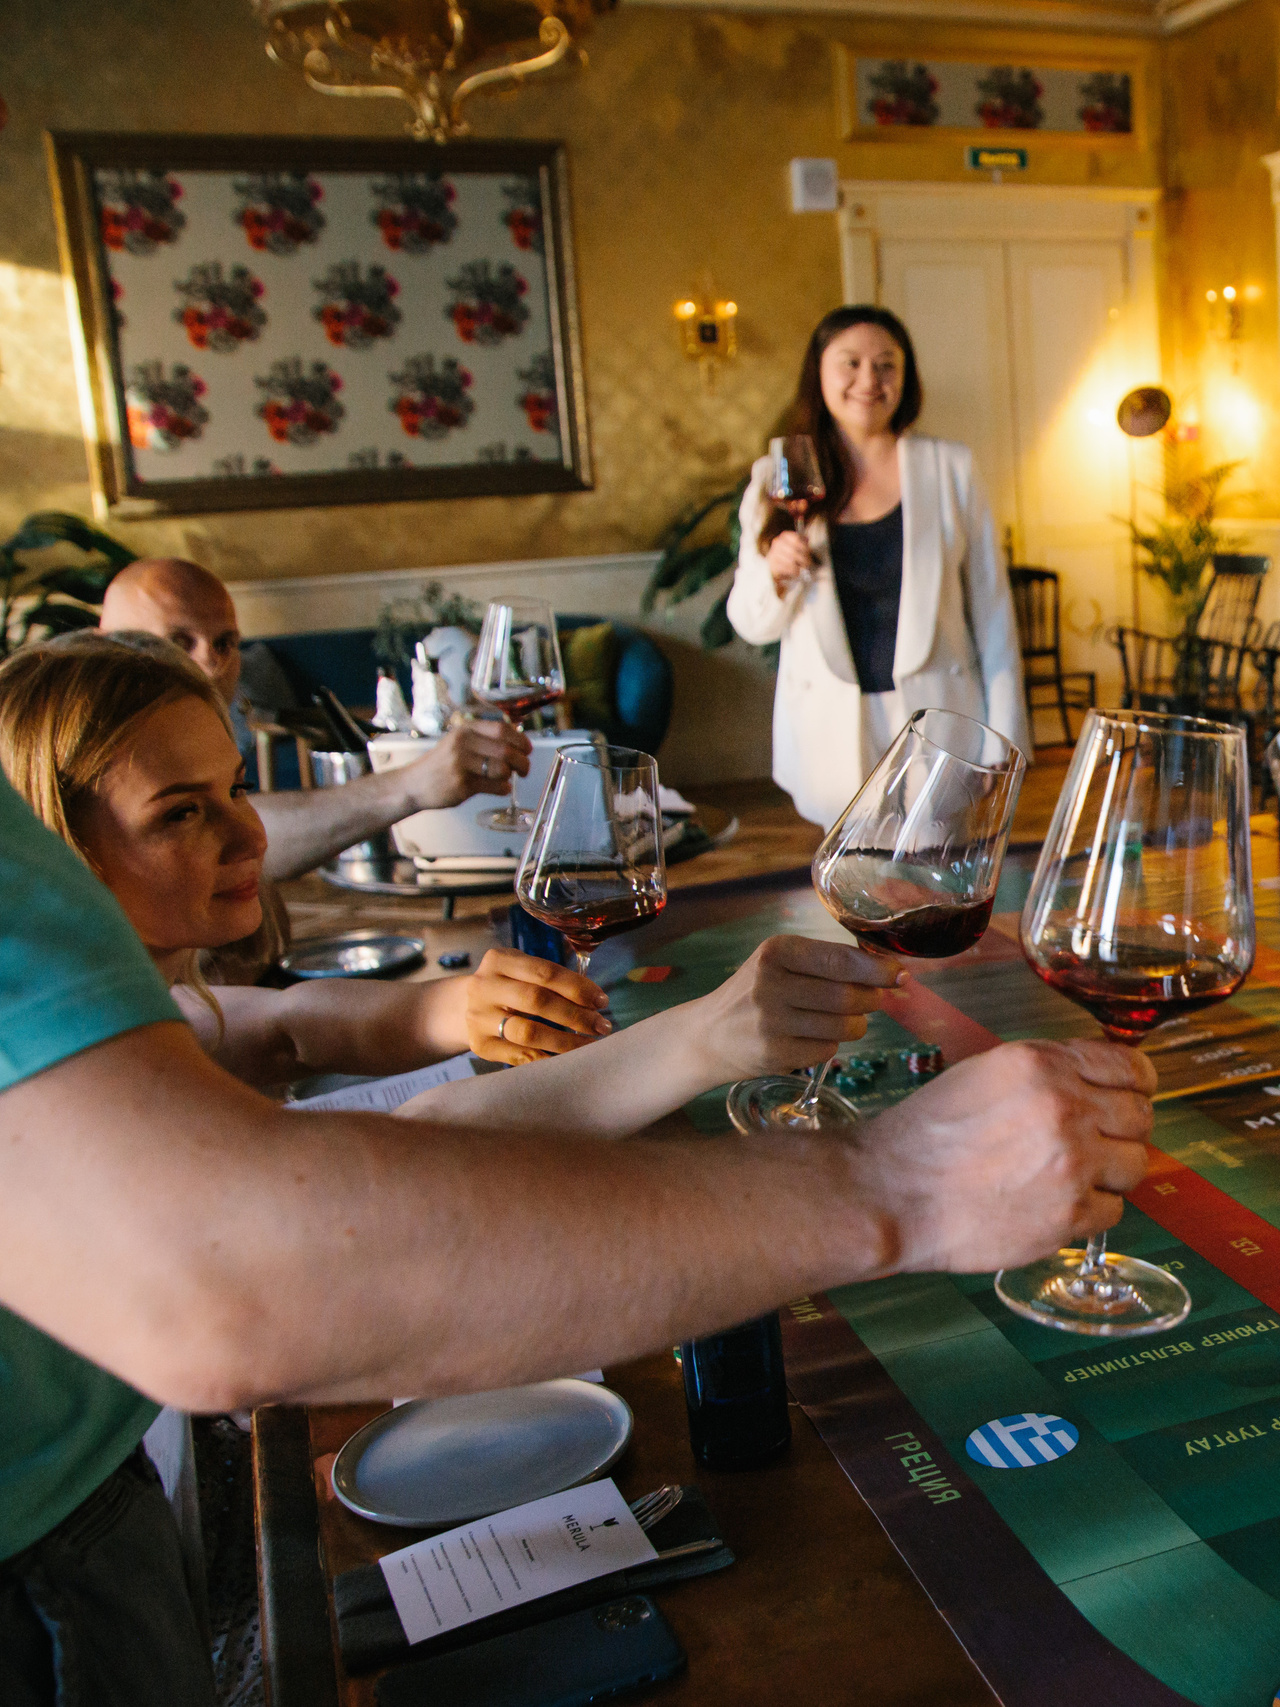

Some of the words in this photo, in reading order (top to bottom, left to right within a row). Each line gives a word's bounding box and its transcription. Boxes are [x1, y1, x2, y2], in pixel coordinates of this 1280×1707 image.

[1202, 1319, 1280, 1348] ГРЮНЕР
[1063, 1341, 1197, 1384] ВЕЛЬТЛИНЕР
[1184, 1424, 1267, 1457] ТУРГАУ
[884, 1431, 962, 1505] ГРЕЦИЯ
[562, 1514, 591, 1552] MERULA
